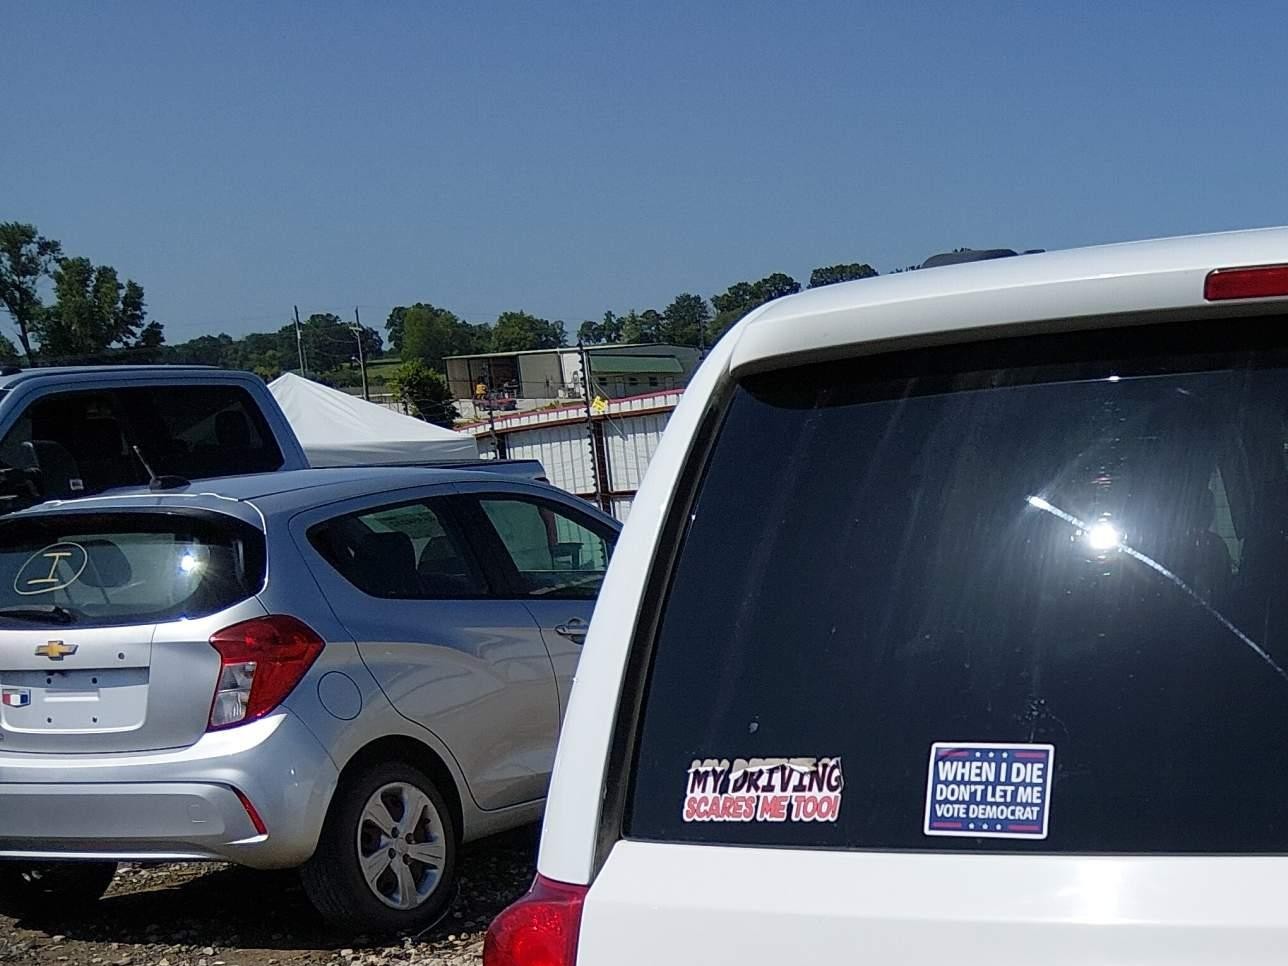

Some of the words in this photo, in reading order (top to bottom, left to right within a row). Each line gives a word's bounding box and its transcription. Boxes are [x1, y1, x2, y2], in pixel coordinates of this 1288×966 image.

[690, 766, 727, 793] MY
[732, 763, 841, 793] DRIVING
[938, 761, 994, 782] WHEN
[1000, 762, 1006, 782] I
[1011, 763, 1043, 784] DIE
[936, 784, 983, 803] DON'T
[987, 786, 1013, 803] LET
[1016, 786, 1042, 803] ME
[686, 796, 755, 819] SCARES
[760, 796, 788, 818] ME
[795, 795, 838, 818] TOO!
[935, 803, 967, 818] VOTE
[969, 805, 1040, 821] DEMOCRAT
